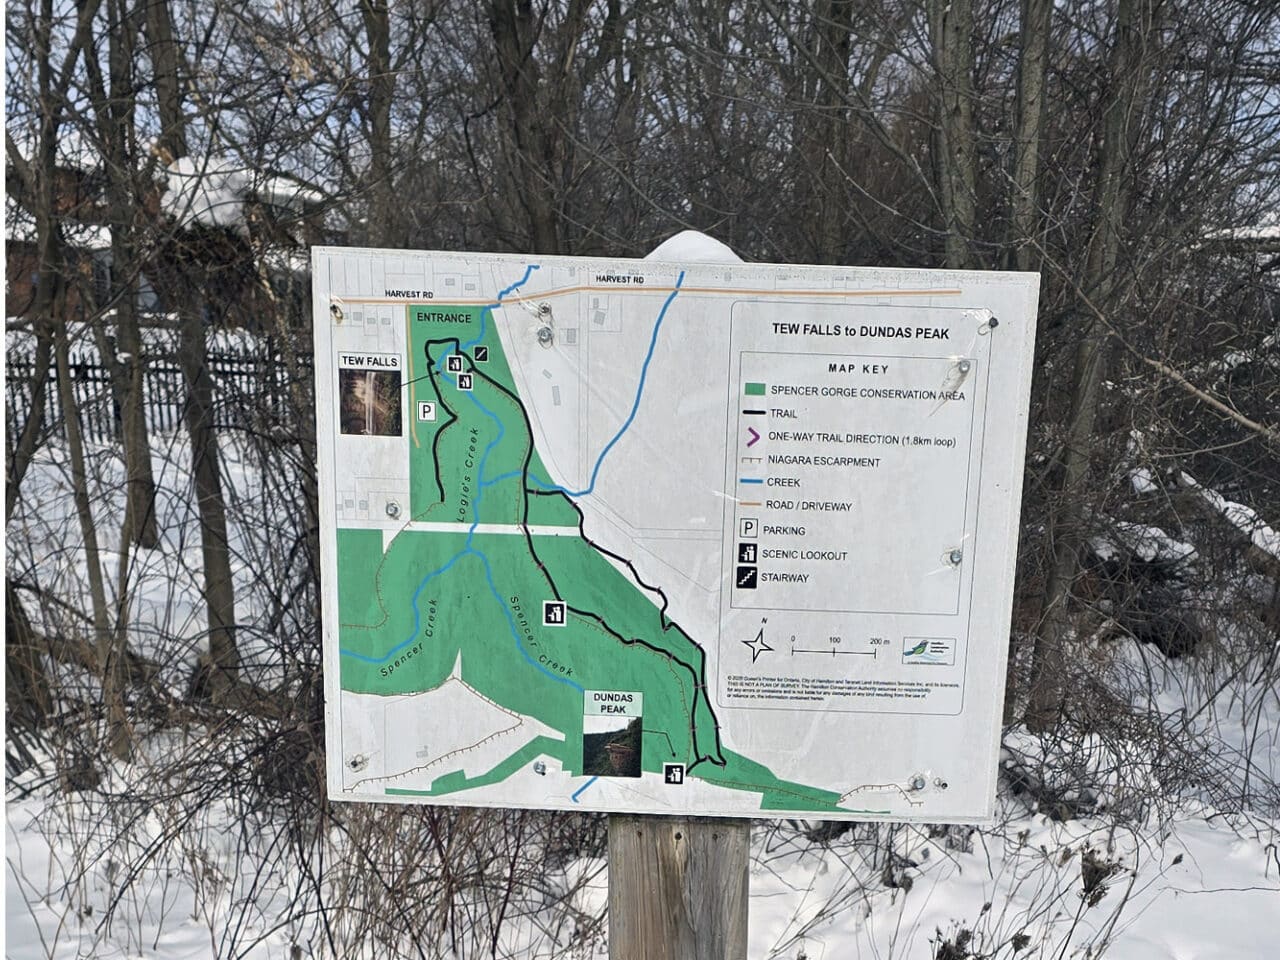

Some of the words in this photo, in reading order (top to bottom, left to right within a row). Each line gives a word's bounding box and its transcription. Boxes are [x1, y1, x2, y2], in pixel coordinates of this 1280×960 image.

[596, 275, 632, 284] HARVEST
[385, 289, 420, 299] HARVEST
[422, 291, 434, 299] RD
[417, 312, 471, 323] ENTRANCE
[773, 323, 799, 334] TEW
[804, 324, 840, 335] FALLS
[845, 326, 856, 336] to
[860, 326, 911, 338] DUNDAS
[916, 328, 948, 339] PEAK
[342, 356, 364, 365] TEW
[367, 357, 397, 366] FALLS
[829, 364, 854, 373] MAP
[863, 365, 888, 373] KEY
[771, 386, 818, 395] SPENCER
[821, 387, 857, 397] GORGE
[860, 389, 936, 399] CONSERVATION
[939, 390, 965, 400] AREA
[423, 405, 431, 418] P
[771, 409, 797, 418] TRAIL
[769, 432, 814, 441] ONE-WAY
[817, 433, 843, 442] TRAIL
[846, 434, 899, 444] DIRECTION
[902, 436, 931, 446] (1.8km
[934, 438, 956, 448] loop)
[769, 455, 811, 464] NIAGARA
[814, 457, 880, 467] ESCARPMENT
[457, 476, 471, 523] Logie's
[465, 428, 478, 468] Creek
[767, 478, 800, 487] CREEK
[767, 500, 793, 509] ROAD
[802, 502, 852, 511] DRIVEWAY
[745, 522, 753, 534] P
[764, 526, 805, 535] PARKING
[762, 550, 798, 559] SCENIC
[801, 551, 847, 560] LOOKOUT
[762, 573, 809, 582] STAIRWAY
[381, 642, 423, 677] Spencer
[425, 600, 437, 637] Creek
[511, 597, 537, 647] Spencer
[539, 655, 573, 676] Creek
[594, 693, 632, 702] DUNDAS
[601, 705, 625, 713] PEAK
